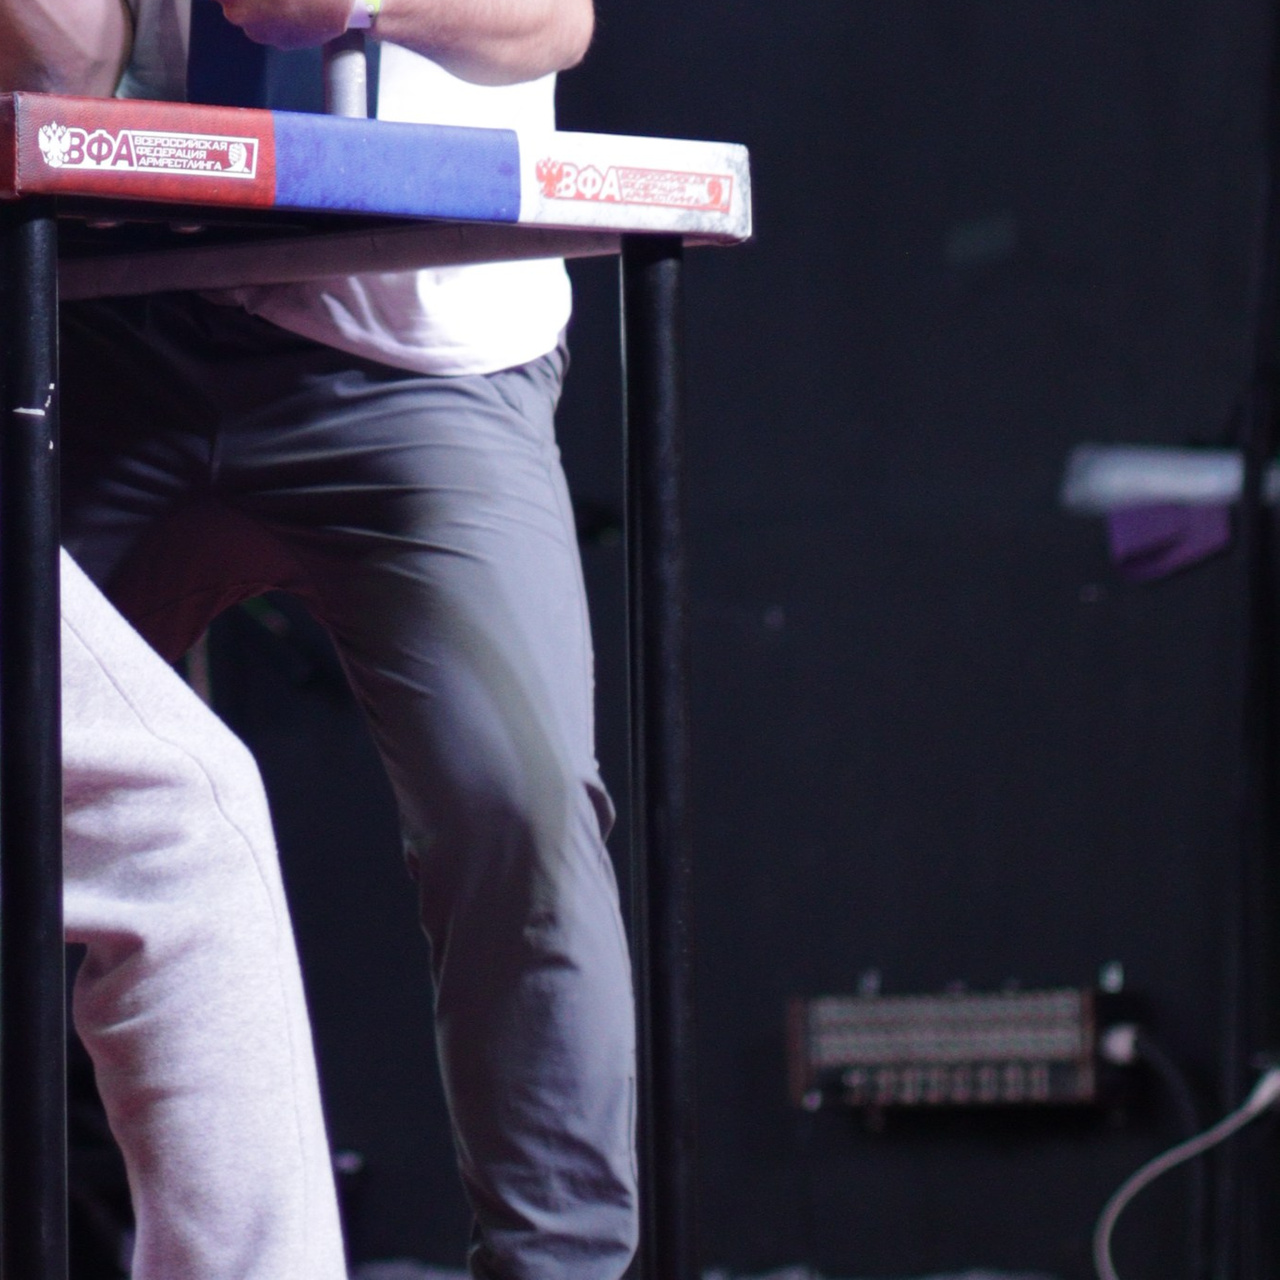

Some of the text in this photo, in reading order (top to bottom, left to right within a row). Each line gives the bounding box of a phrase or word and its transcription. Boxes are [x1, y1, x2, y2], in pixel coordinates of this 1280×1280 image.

[68, 130, 135, 168] ВФА
[134, 136, 228, 151] ВСЕРОССИЙСКАЯ
[136, 146, 207, 160] ФЕДЕРАЦИЯ
[138, 157, 223, 171] АРМРЕСТЛИНГА
[561, 163, 621, 202] ВФА
